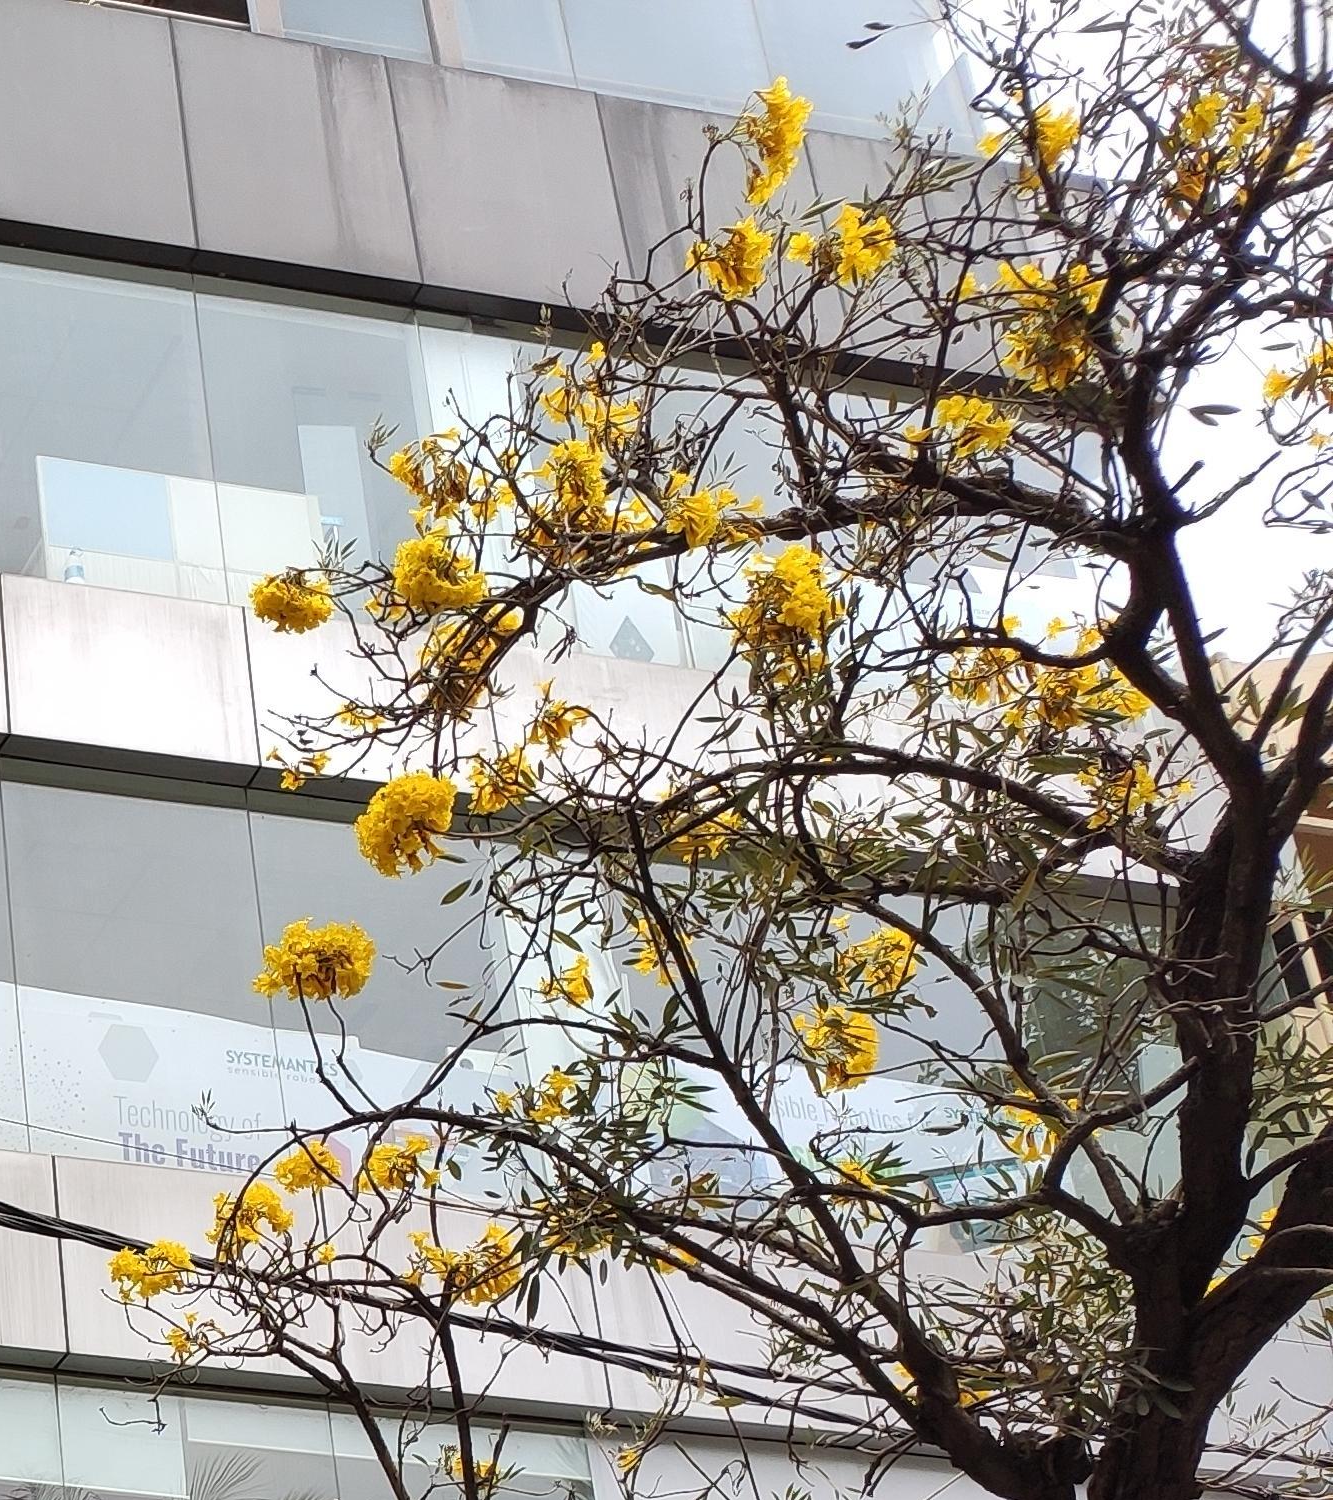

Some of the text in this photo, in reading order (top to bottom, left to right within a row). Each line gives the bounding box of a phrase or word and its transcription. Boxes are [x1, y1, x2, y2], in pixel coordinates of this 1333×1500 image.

[225, 1049, 339, 1077] SYSTEMANTCS
[118, 1131, 261, 1173] The Future
